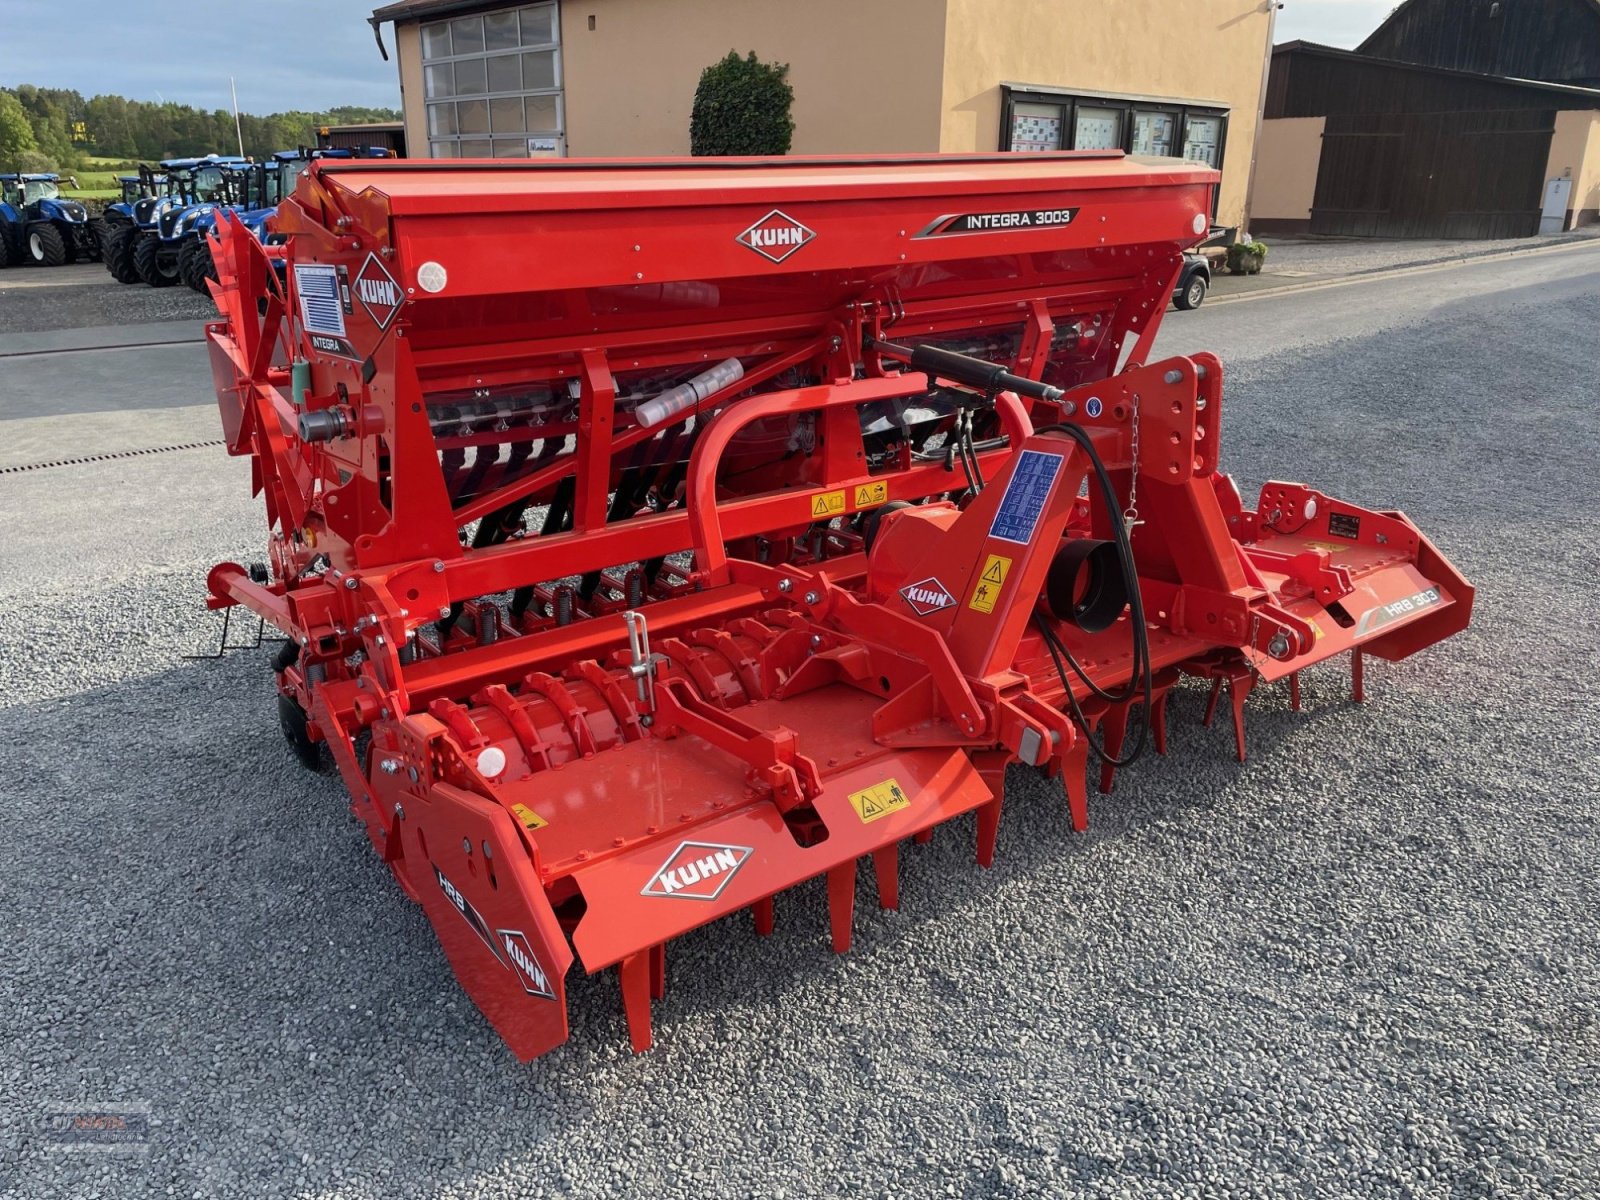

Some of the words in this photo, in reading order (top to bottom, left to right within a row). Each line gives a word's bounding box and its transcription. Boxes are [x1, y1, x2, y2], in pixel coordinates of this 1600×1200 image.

[967, 212, 1031, 228] INTEGRA
[1035, 210, 1070, 224] 3003
[751, 227, 803, 247] KUHN
[360, 279, 396, 306] KUHN
[312, 336, 340, 352] INTEGRA
[907, 587, 948, 607] KUHN
[1384, 601, 1414, 616] HRB
[1412, 590, 1438, 605] 303
[659, 848, 738, 894] KUHN
[439, 872, 465, 911] HRB
[505, 934, 545, 993] KUHN
